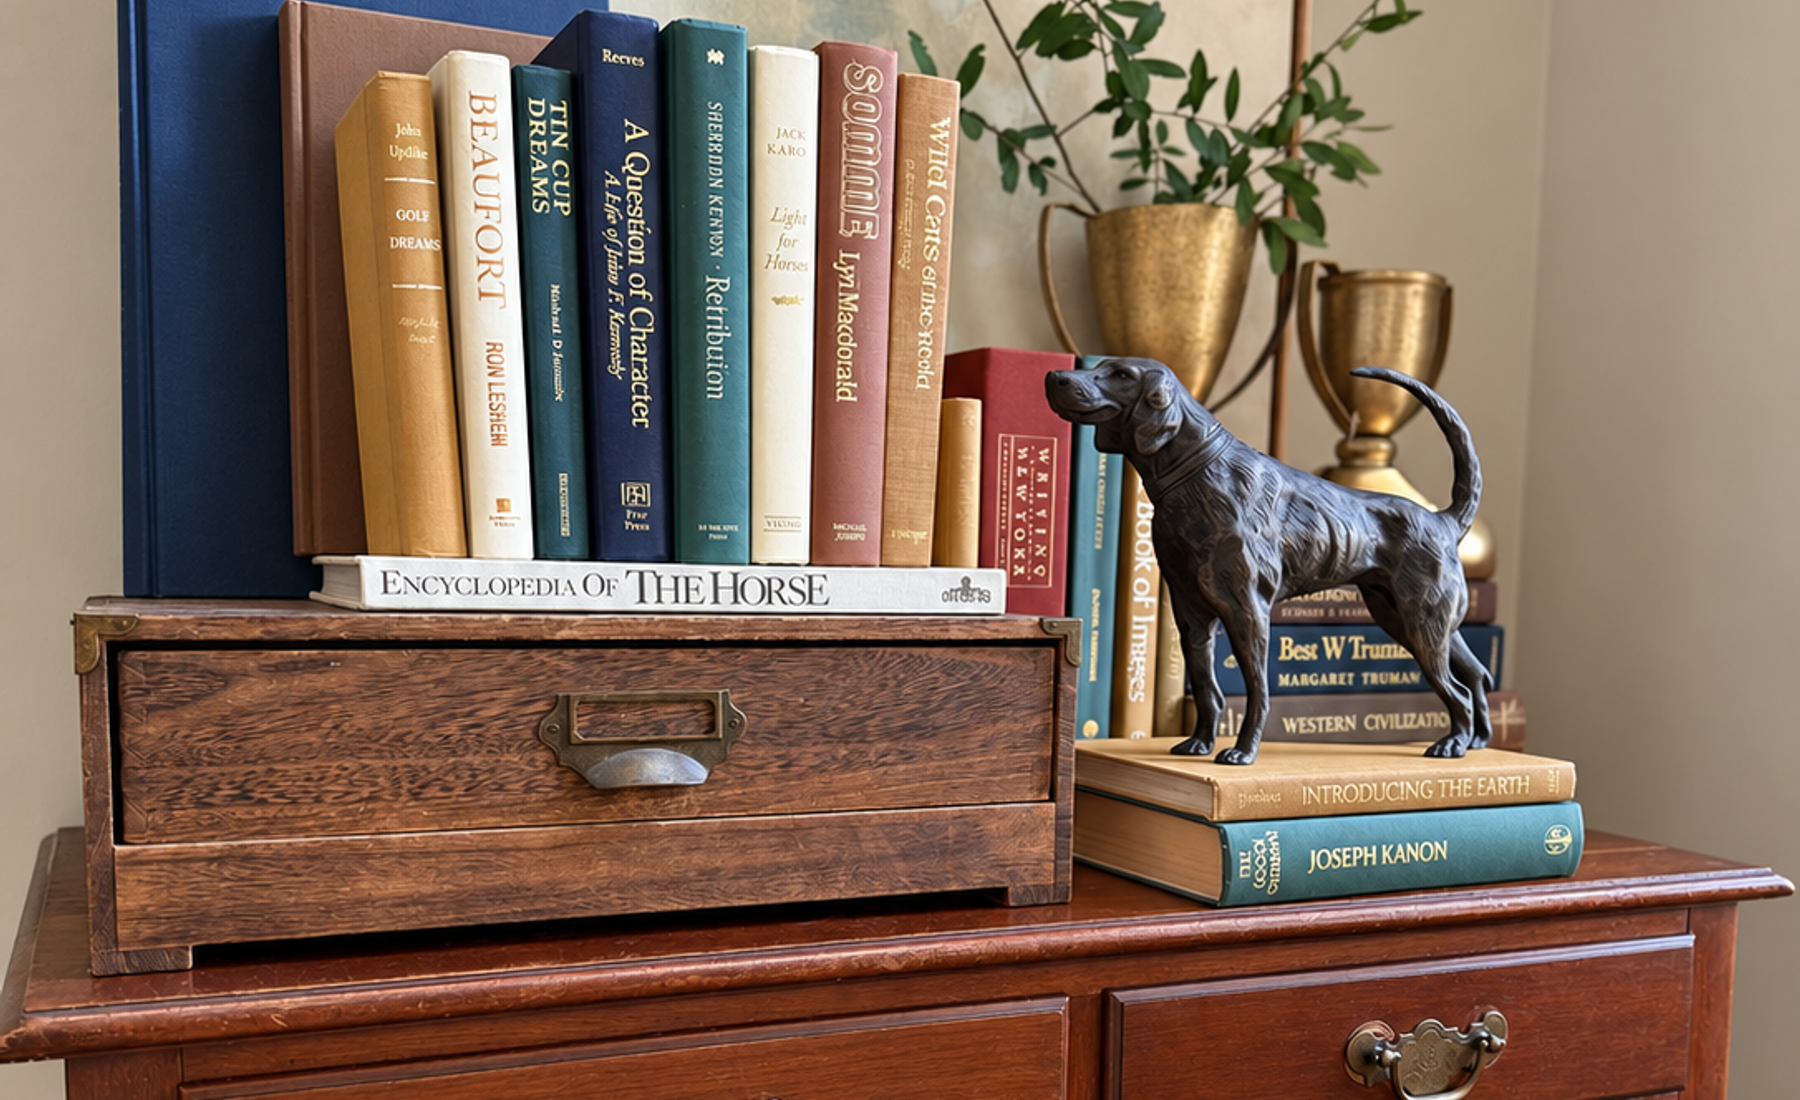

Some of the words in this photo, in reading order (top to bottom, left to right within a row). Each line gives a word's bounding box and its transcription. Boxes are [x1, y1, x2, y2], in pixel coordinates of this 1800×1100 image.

[602, 48, 645, 68] Reeves
[550, 100, 569, 150] TIN
[623, 118, 649, 143] A
[776, 127, 806, 141] JACK
[528, 97, 550, 214] DREAMS
[468, 90, 506, 310] BEAUFORT
[552, 159, 571, 216] CUP
[396, 209, 431, 223] GOLF
[621, 151, 652, 265] Question
[770, 207, 807, 230] Light
[390, 236, 441, 252] DREAMS
[776, 232, 799, 252] for
[764, 253, 809, 273] Horses
[628, 272, 653, 302] of
[486, 341, 505, 379] RON
[628, 306, 655, 429] Character
[380, 569, 577, 597] ENCYCLOPEDIA
[625, 569, 706, 605] THE
[709, 570, 830, 606] HORSE
[1133, 577, 1156, 609] of
[1322, 636, 1346, 660] W
[1278, 672, 1355, 687] MARGARET
[1282, 713, 1357, 734] WESTERN
[1301, 779, 1433, 806] INTRODUCING
[1437, 777, 1473, 798] THE
[1476, 775, 1530, 797] EARTH
[1307, 844, 1377, 875] JOSEPH
[1380, 840, 1448, 865] KANON
